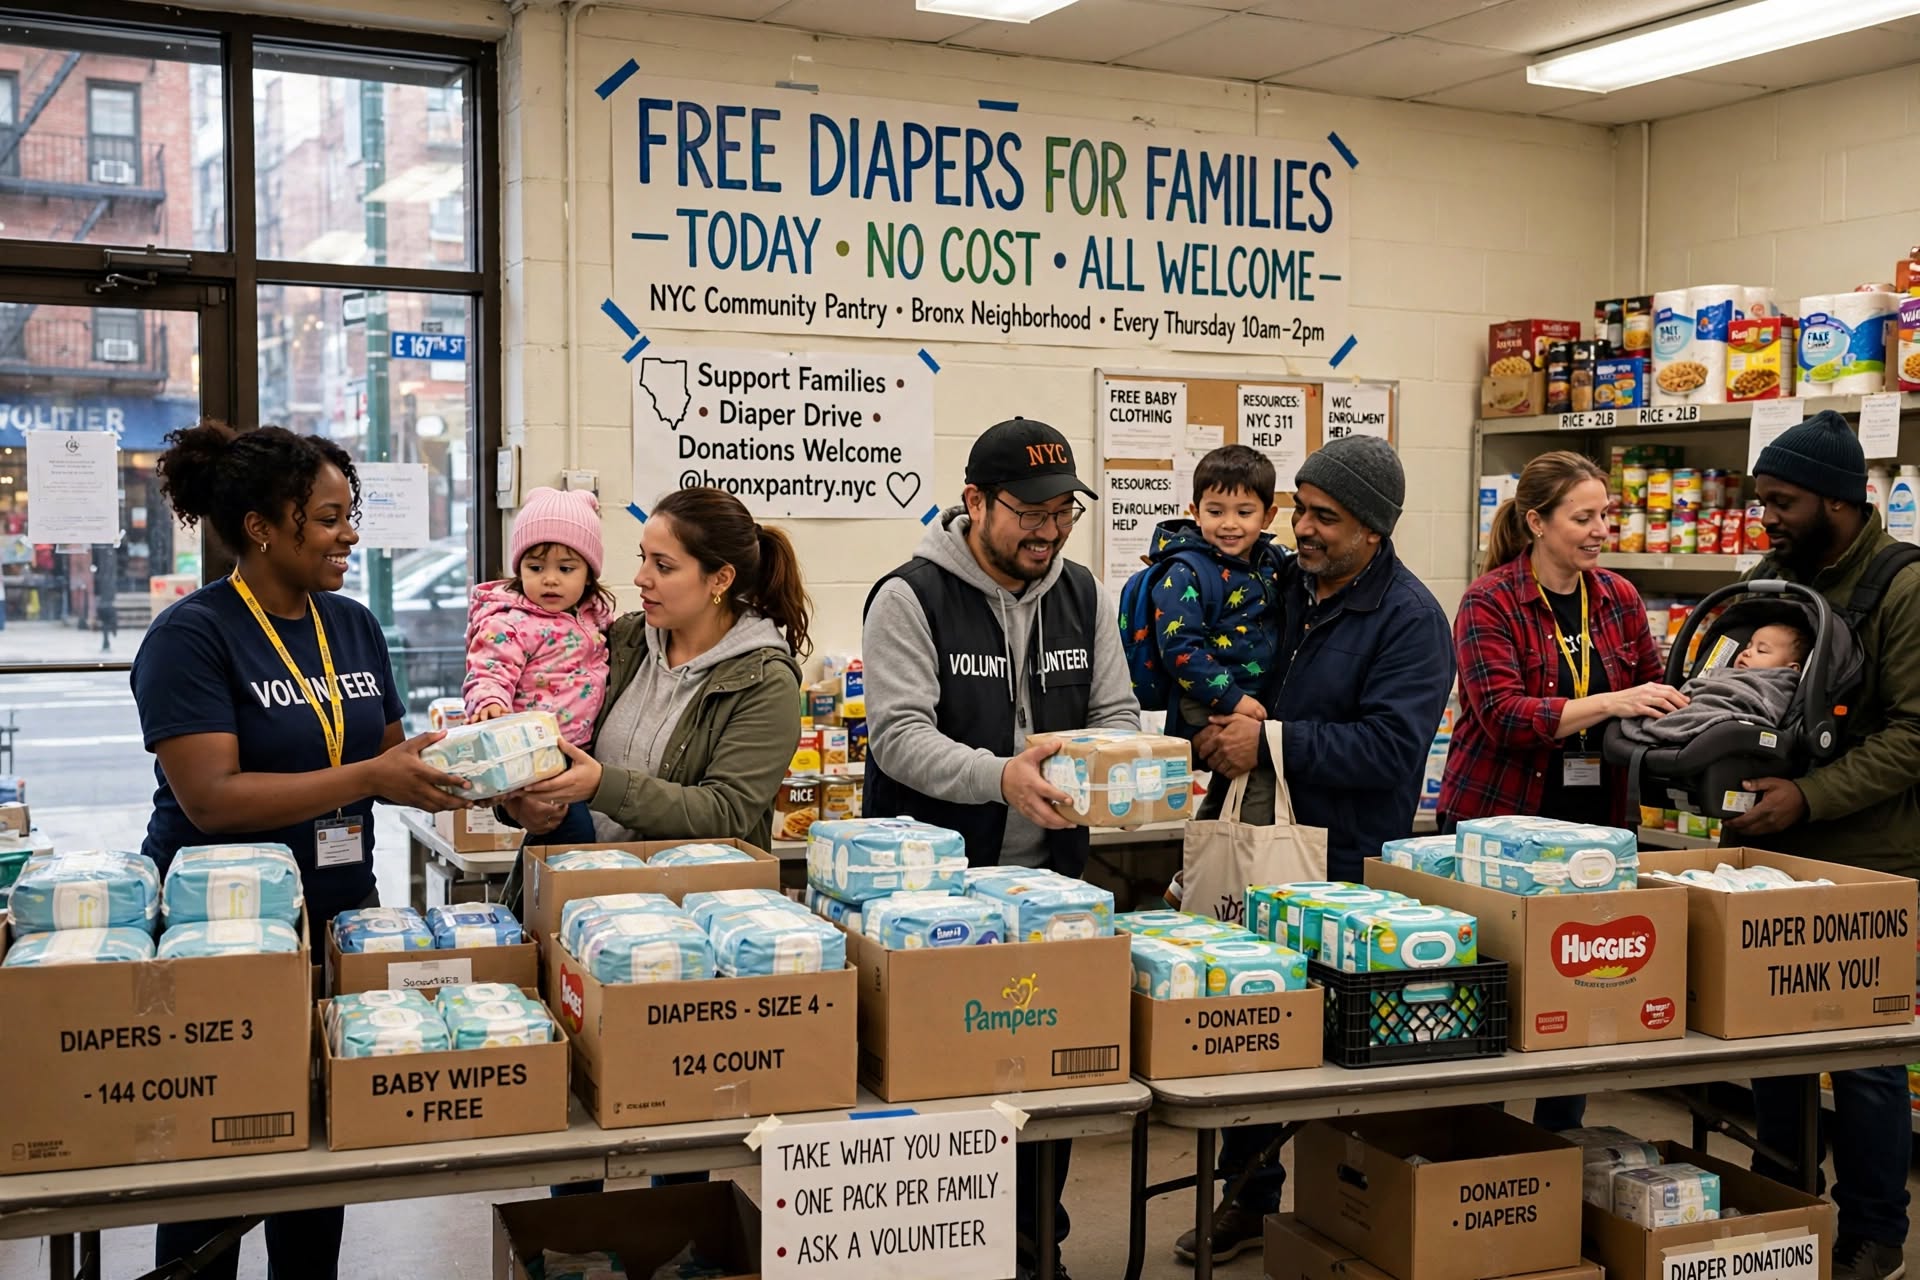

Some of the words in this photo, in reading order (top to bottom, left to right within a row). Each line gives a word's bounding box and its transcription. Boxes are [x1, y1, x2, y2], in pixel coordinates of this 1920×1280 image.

[638, 98, 781, 193] FREE
[810, 113, 1024, 211] DIAPERS
[1046, 136, 1127, 218] FOR
[1147, 146, 1332, 233] FAMILIES
[676, 208, 821, 274] TODAY
[867, 222, 924, 280] NO
[940, 227, 1040, 286] COST
[1079, 235, 1144, 291] ALL
[1157, 241, 1314, 301] WELCOME
[651, 284, 696, 312] NYC
[705, 286, 816, 325] Community
[826, 293, 887, 328] Pantry
[912, 297, 964, 324] Bronx
[972, 300, 1090, 333] Neighborhood
[1114, 308, 1159, 340] Every
[1164, 310, 1235, 344] Thursday
[395, 335, 405, 355] E
[449, 338, 463, 354] ST
[698, 362, 790, 394] Support
[799, 366, 885, 393] Families
[1111, 390, 1140, 404] FREE
[1145, 391, 1177, 405] BABY
[1244, 394, 1299, 407] RESOURCES:
[1332, 397, 1352, 408] WIC
[720, 400, 795, 431] Diaper
[805, 403, 862, 427] Drive
[1110, 408, 1172, 423] CLOTHING
[1247, 413, 1271, 428] NYC
[1275, 415, 1292, 429] 311
[1329, 412, 1384, 424] ENROLLMENT
[1562, 414, 1584, 427] RICE
[1595, 412, 1614, 426] 2LB
[1640, 409, 1663, 423] RICE
[1676, 406, 1697, 421] 2LB
[679, 435, 794, 461] Donations
[803, 438, 901, 463] Welcome
[1253, 433, 1282, 446] HELP
[1026, 443, 1068, 467] NYC
[679, 470, 877, 503] @bronxpantry.nyc
[1111, 478, 1171, 490] RESOURCES:
[1112, 502, 1180, 515] ENROLLMENT
[1113, 519, 1138, 530] HELP
[949, 653, 1007, 679] VOLUNT
[789, 788, 815, 802] RICE
[1742, 917, 1805, 949] DIAPER
[1814, 909, 1908, 944] DONATIONS
[1561, 934, 1648, 965] HUGGIES
[1768, 962, 1830, 996] THANK
[1838, 956, 1880, 990] YOU!
[648, 1000, 737, 1025] DIAPERS
[758, 995, 802, 1017] SIZE
[808, 994, 819, 1014] 4
[964, 1000, 1058, 1034] Pampers
[1198, 1007, 1280, 1029] DONATED
[61, 1025, 161, 1053] DIAPERS
[185, 1020, 233, 1044] SIZE
[242, 1019, 253, 1040] 3
[1205, 1033, 1279, 1055] DIAPERS
[673, 1054, 707, 1076] 124
[713, 1049, 785, 1073] COUNT
[99, 1082, 135, 1104] 144
[142, 1075, 217, 1101] COUNT
[372, 1070, 440, 1096] BABY
[448, 1064, 527, 1089] WIPES
[424, 1097, 483, 1123] FREE
[778, 1142, 830, 1171] TAKE
[840, 1137, 895, 1165] WHAT
[904, 1133, 940, 1160] YOU
[950, 1129, 996, 1156] NEED
[795, 1187, 833, 1216] ONE
[844, 1183, 887, 1211] PACK
[897, 1179, 928, 1206] PER
[938, 1172, 998, 1202] FAMILY
[1461, 1177, 1539, 1203] DONATED
[1465, 1205, 1537, 1230] DIAPERS
[798, 1234, 838, 1264] ASK
[848, 1232, 861, 1259] A
[870, 1220, 986, 1256] VOLUNTEER
[1671, 1256, 1727, 1280] DIAPER
[1733, 1244, 1813, 1276] DONATIONS
